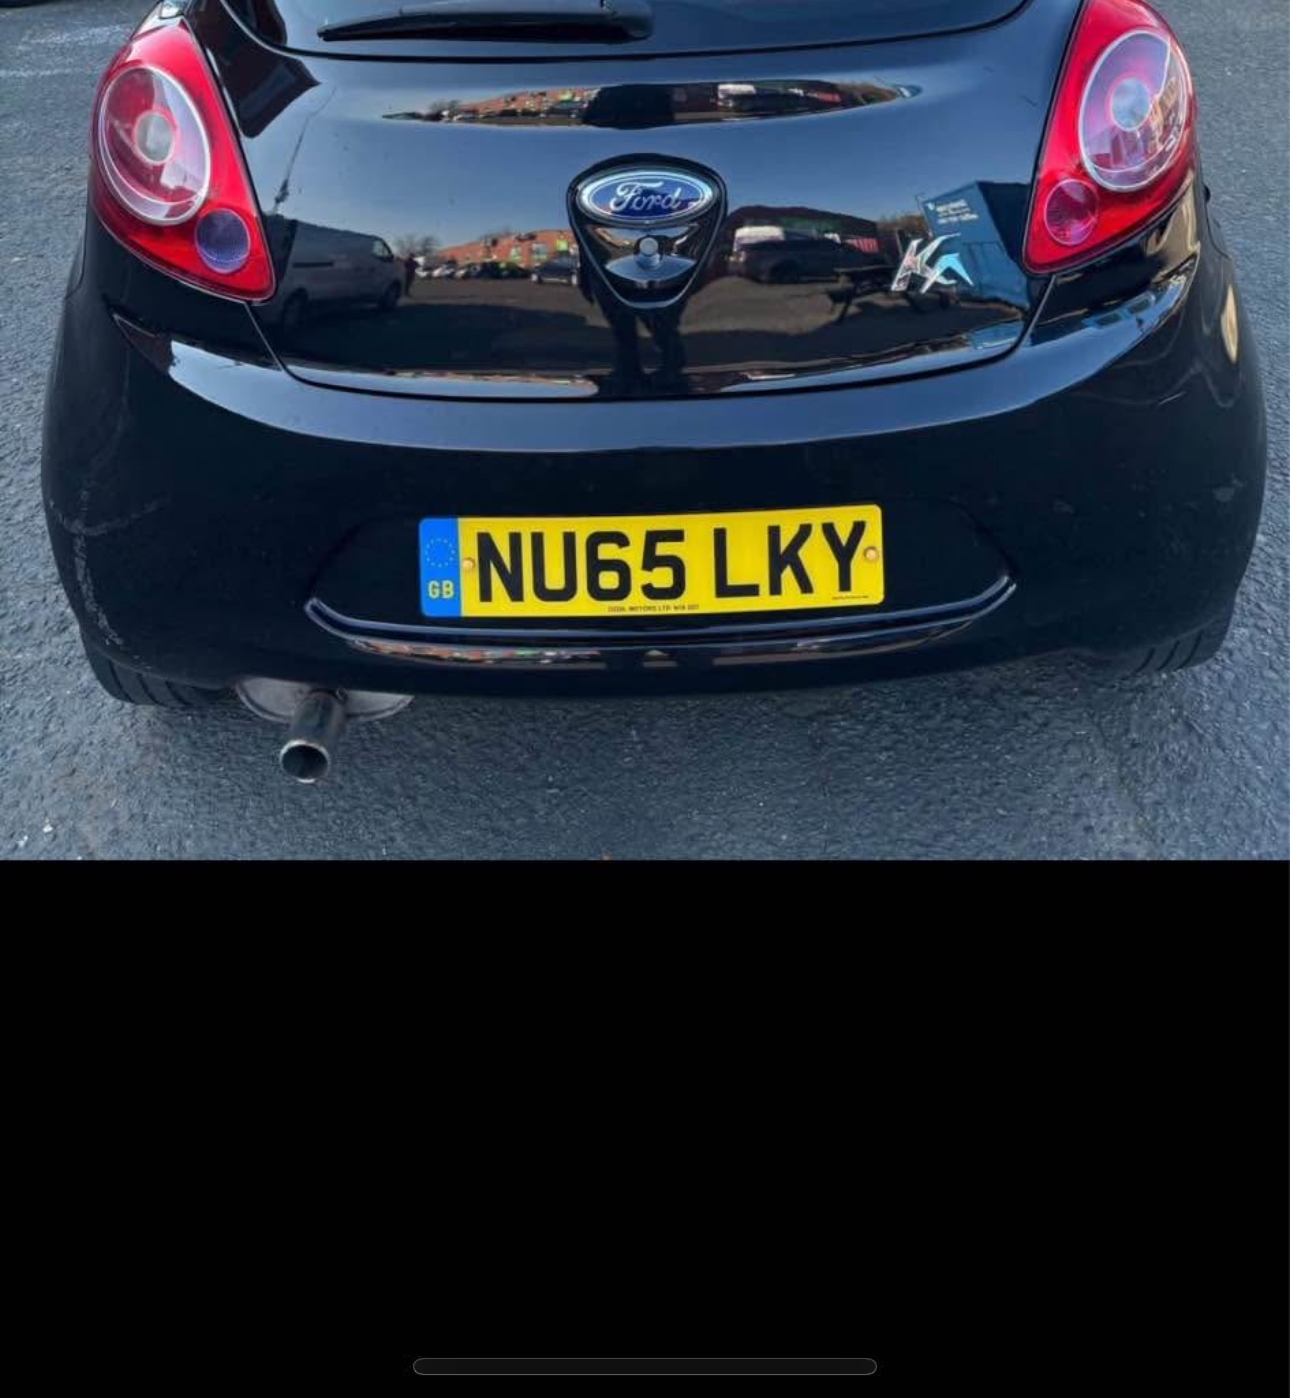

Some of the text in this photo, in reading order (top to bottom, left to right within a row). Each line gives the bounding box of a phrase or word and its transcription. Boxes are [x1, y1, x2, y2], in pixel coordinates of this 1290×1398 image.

[609, 180, 682, 212] Ford
[476, 520, 867, 603] NU65 LKY
[428, 579, 454, 599] GB
